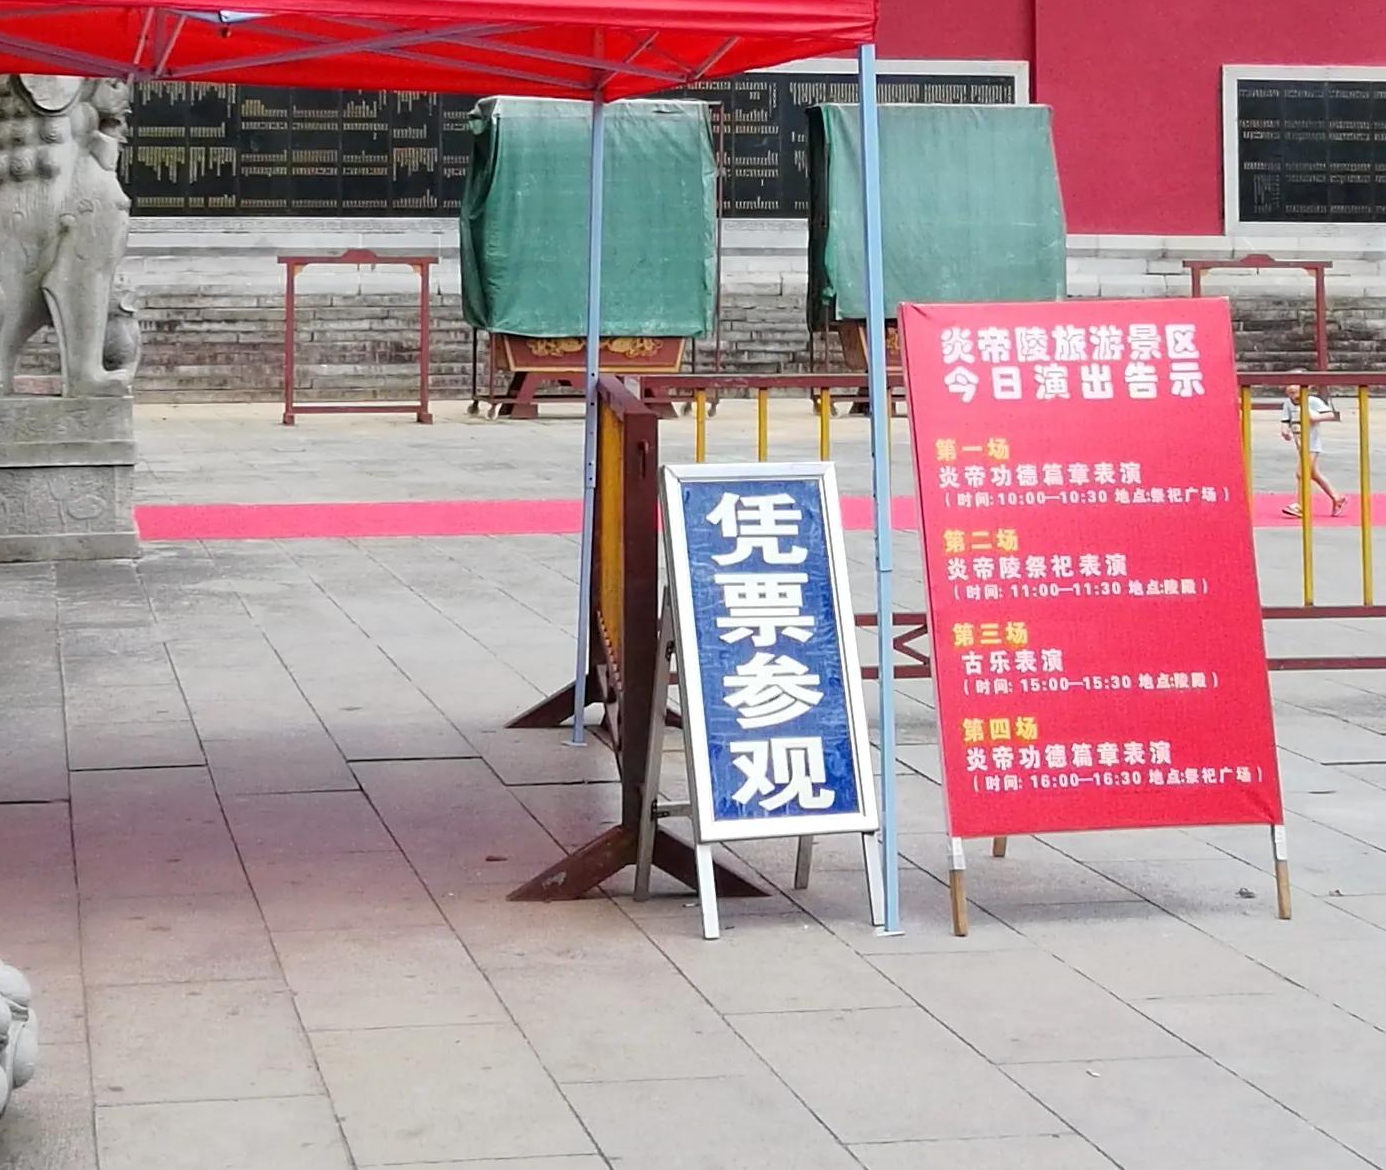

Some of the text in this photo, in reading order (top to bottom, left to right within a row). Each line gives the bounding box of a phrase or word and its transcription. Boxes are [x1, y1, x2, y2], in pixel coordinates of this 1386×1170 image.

[940, 323, 1200, 364] 炎帝陵旅游景区
[943, 361, 1205, 403] 今日演出告示
[935, 438, 1010, 462] 第一场
[939, 462, 1141, 488] 炎帝功德篇章表演
[944, 528, 1019, 553] 第二场
[947, 554, 1128, 580] 炎帝陵祭祀表演
[952, 622, 1029, 647] 第三场
[706, 492, 835, 811] 凭票参观
[961, 648, 1063, 675] 古乐表演
[962, 717, 1038, 742] 第四场
[966, 741, 1172, 771] 炎帝功德篇章表演
